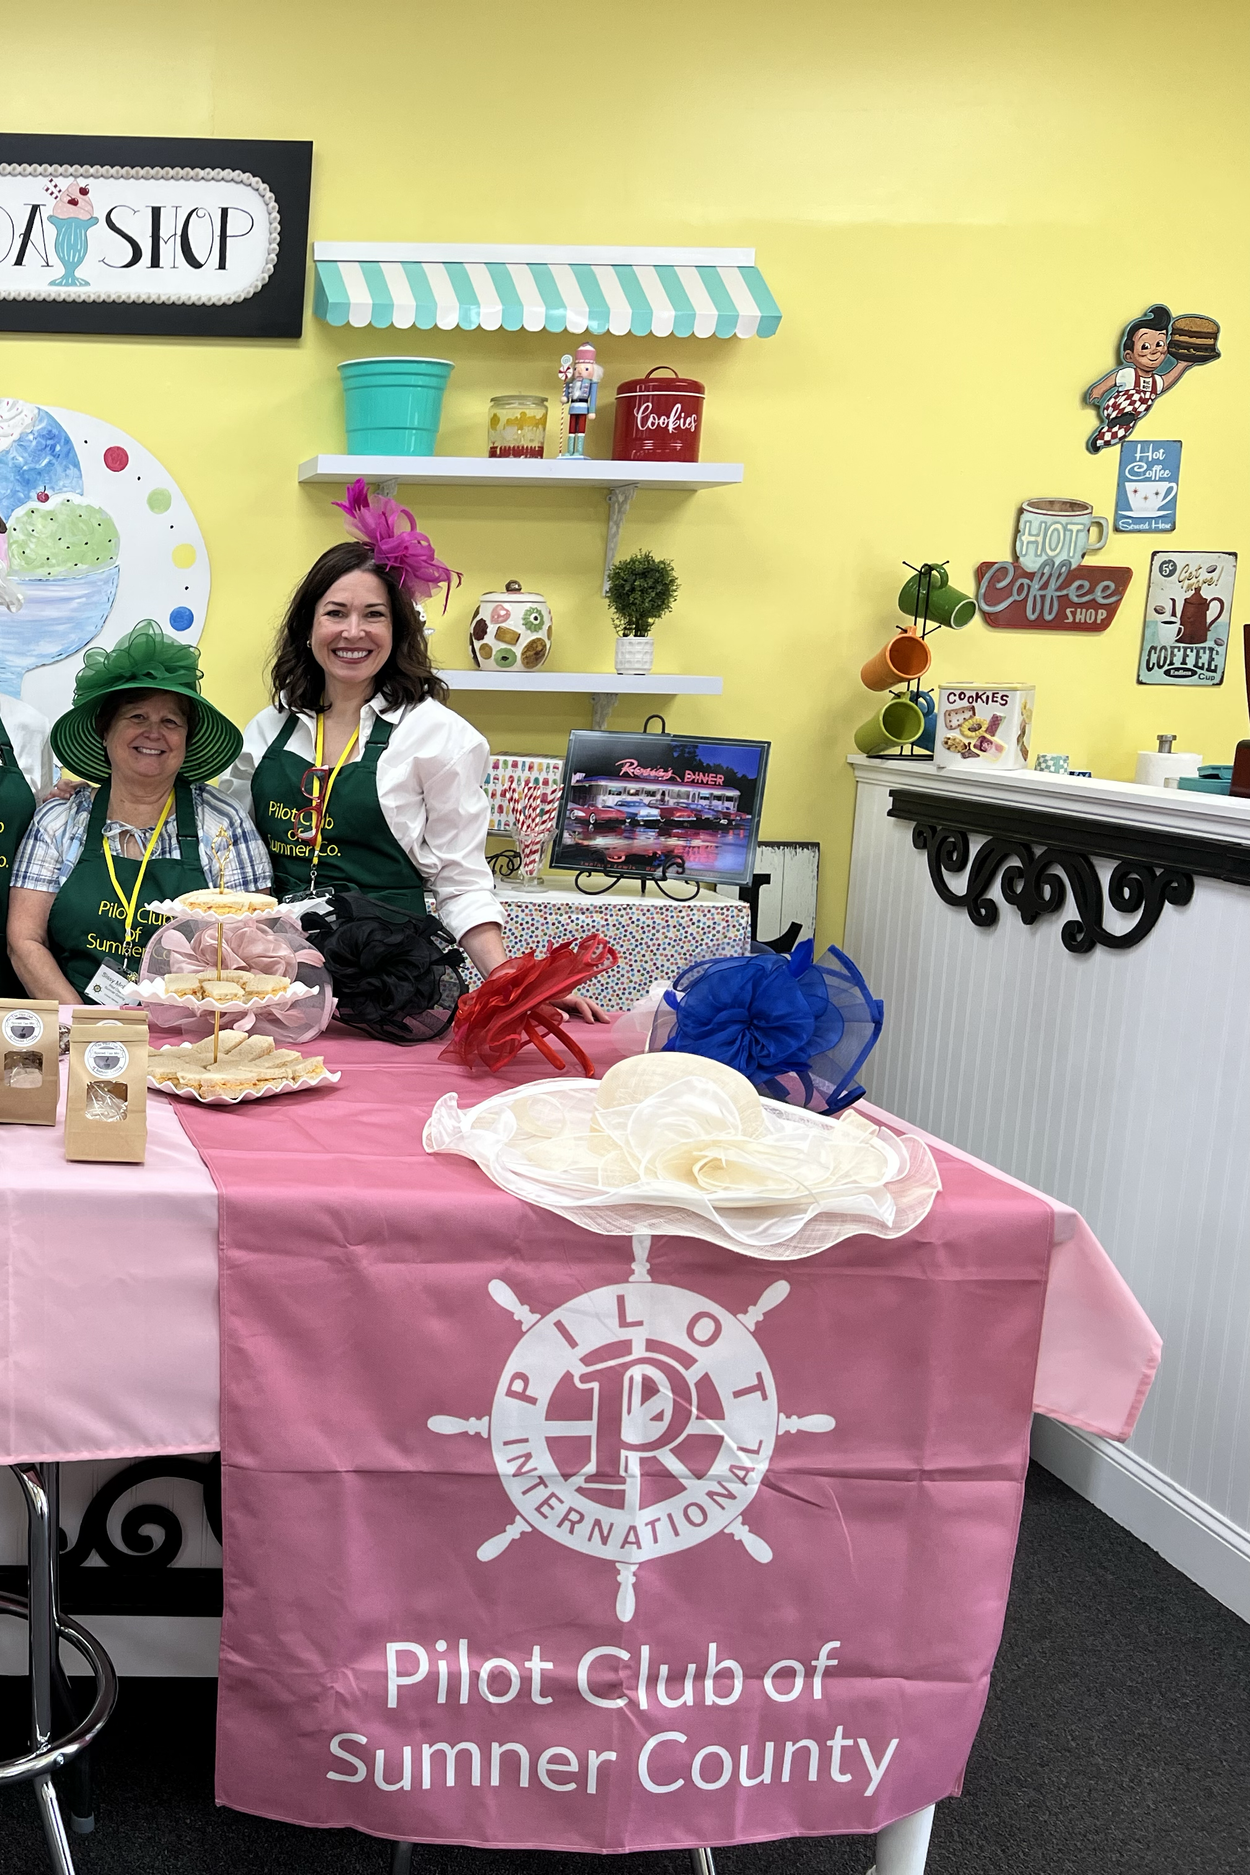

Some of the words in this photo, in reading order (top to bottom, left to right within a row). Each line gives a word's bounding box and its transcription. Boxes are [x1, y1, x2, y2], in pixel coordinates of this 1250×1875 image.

[99, 204, 255, 270] SHOP
[634, 402, 698, 434] Cookies
[1135, 443, 1166, 461] Hot
[1125, 462, 1171, 480] Coffee
[1020, 520, 1086, 558] HOT
[1178, 563, 1203, 583] Get
[978, 558, 1123, 621] Coffee
[1064, 608, 1107, 624] SHOP
[1146, 645, 1220, 674] COFFEE
[1198, 673, 1216, 681] Cup
[947, 691, 1010, 706] COOKIES
[683, 769, 725, 786] DINER
[269, 801, 298, 822] Pilot
[268, 834, 313, 857] umner
[98, 900, 129, 919] Pilo
[504, 1294, 768, 1407] PILOT
[502, 1436, 765, 1551] INTERNATIONAL
[386, 1639, 554, 1708] Pilot
[577, 1642, 743, 1710] Club
[763, 1640, 840, 1703] of
[326, 1731, 617, 1794] Sumner
[638, 1725, 899, 1797] County
